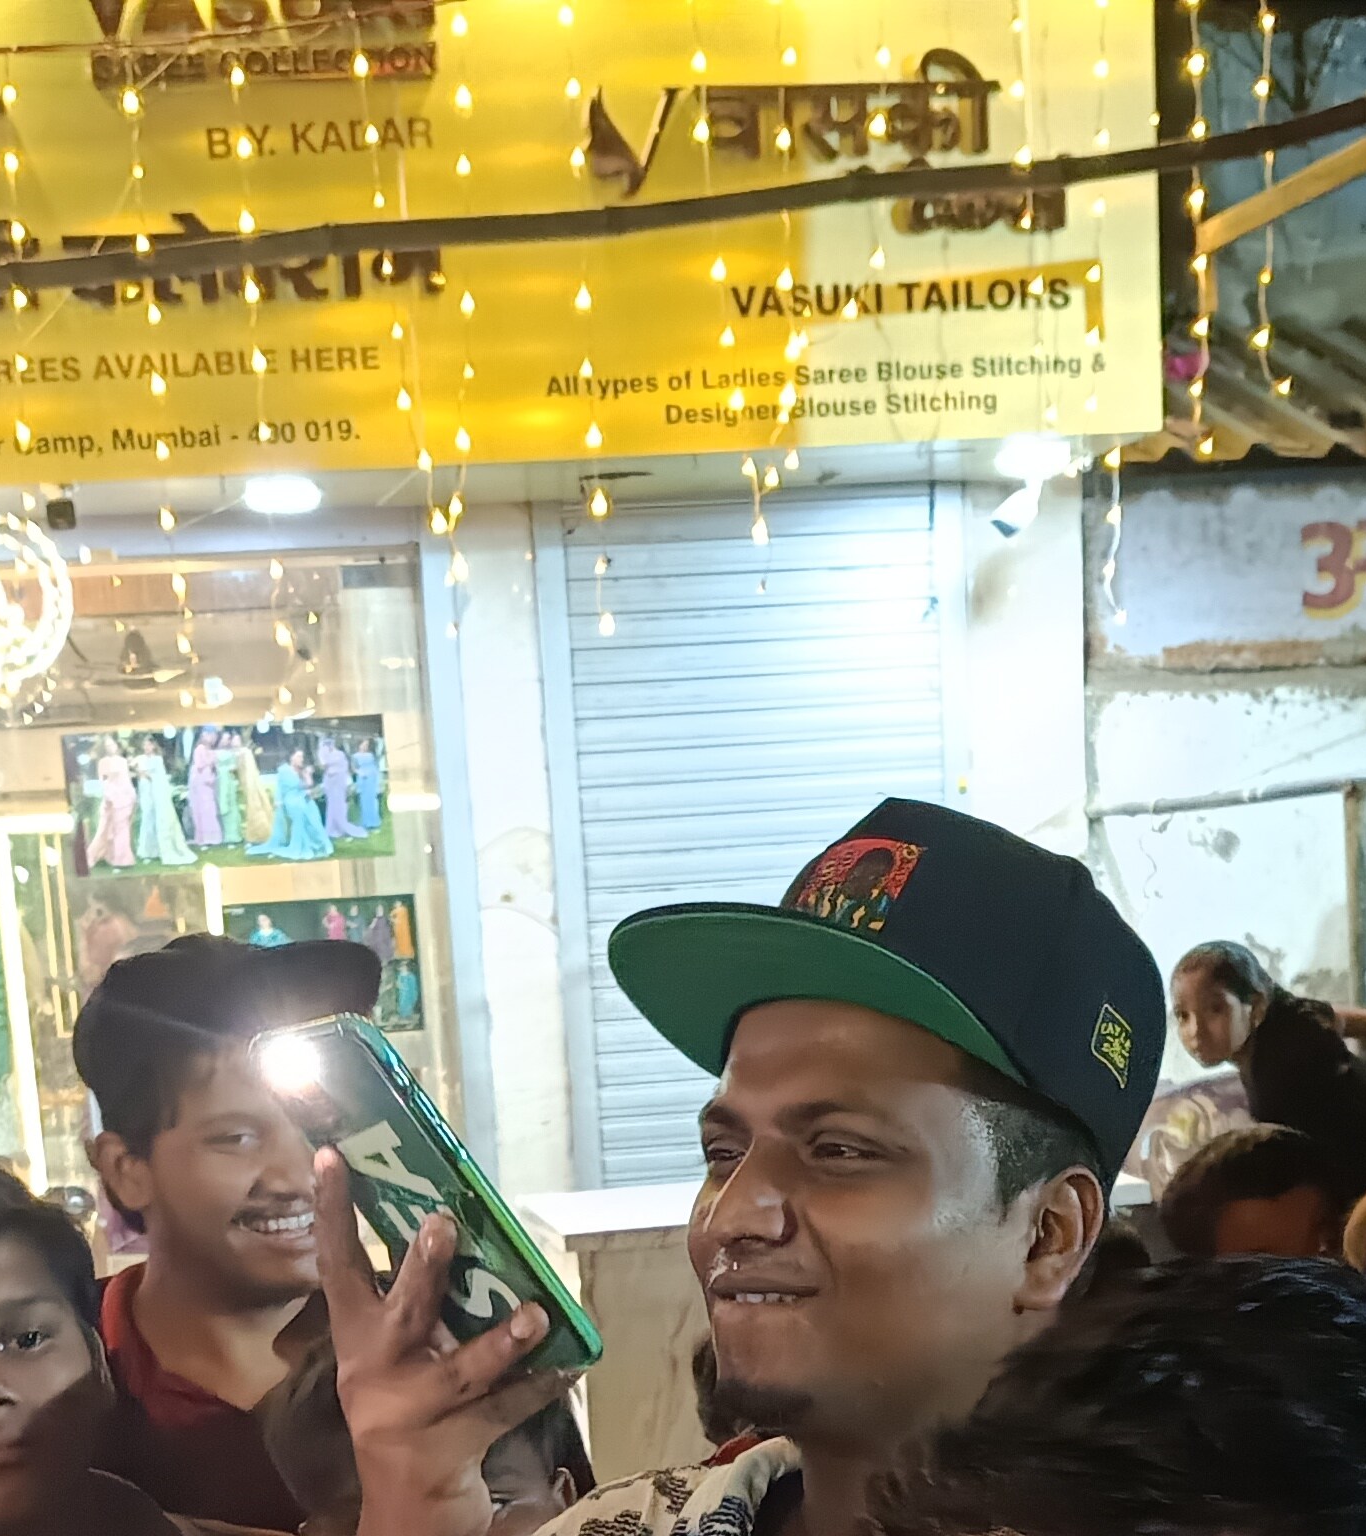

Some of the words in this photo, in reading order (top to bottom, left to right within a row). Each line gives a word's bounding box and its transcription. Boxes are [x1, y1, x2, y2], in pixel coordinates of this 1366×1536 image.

[730, 283, 883, 318] VASUKI
[897, 278, 1072, 313] TAILORS
[92, 349, 278, 381] AVAILABLE
[290, 346, 381, 373] HERE
[546, 375, 580, 398] All
[668, 370, 692, 392] of
[702, 366, 785, 391] Ladies
[795, 364, 868, 387] Saree
[877, 360, 964, 383] Blouse
[972, 355, 1082, 379] Stitching
[1091, 353, 1107, 373] &
[665, 402, 781, 428] Designer
[790, 396, 877, 419] Blouse
[886, 390, 998, 415] Stitching
[112, 424, 220, 451] Mumbai
[304, 418, 362, 443] 019.
